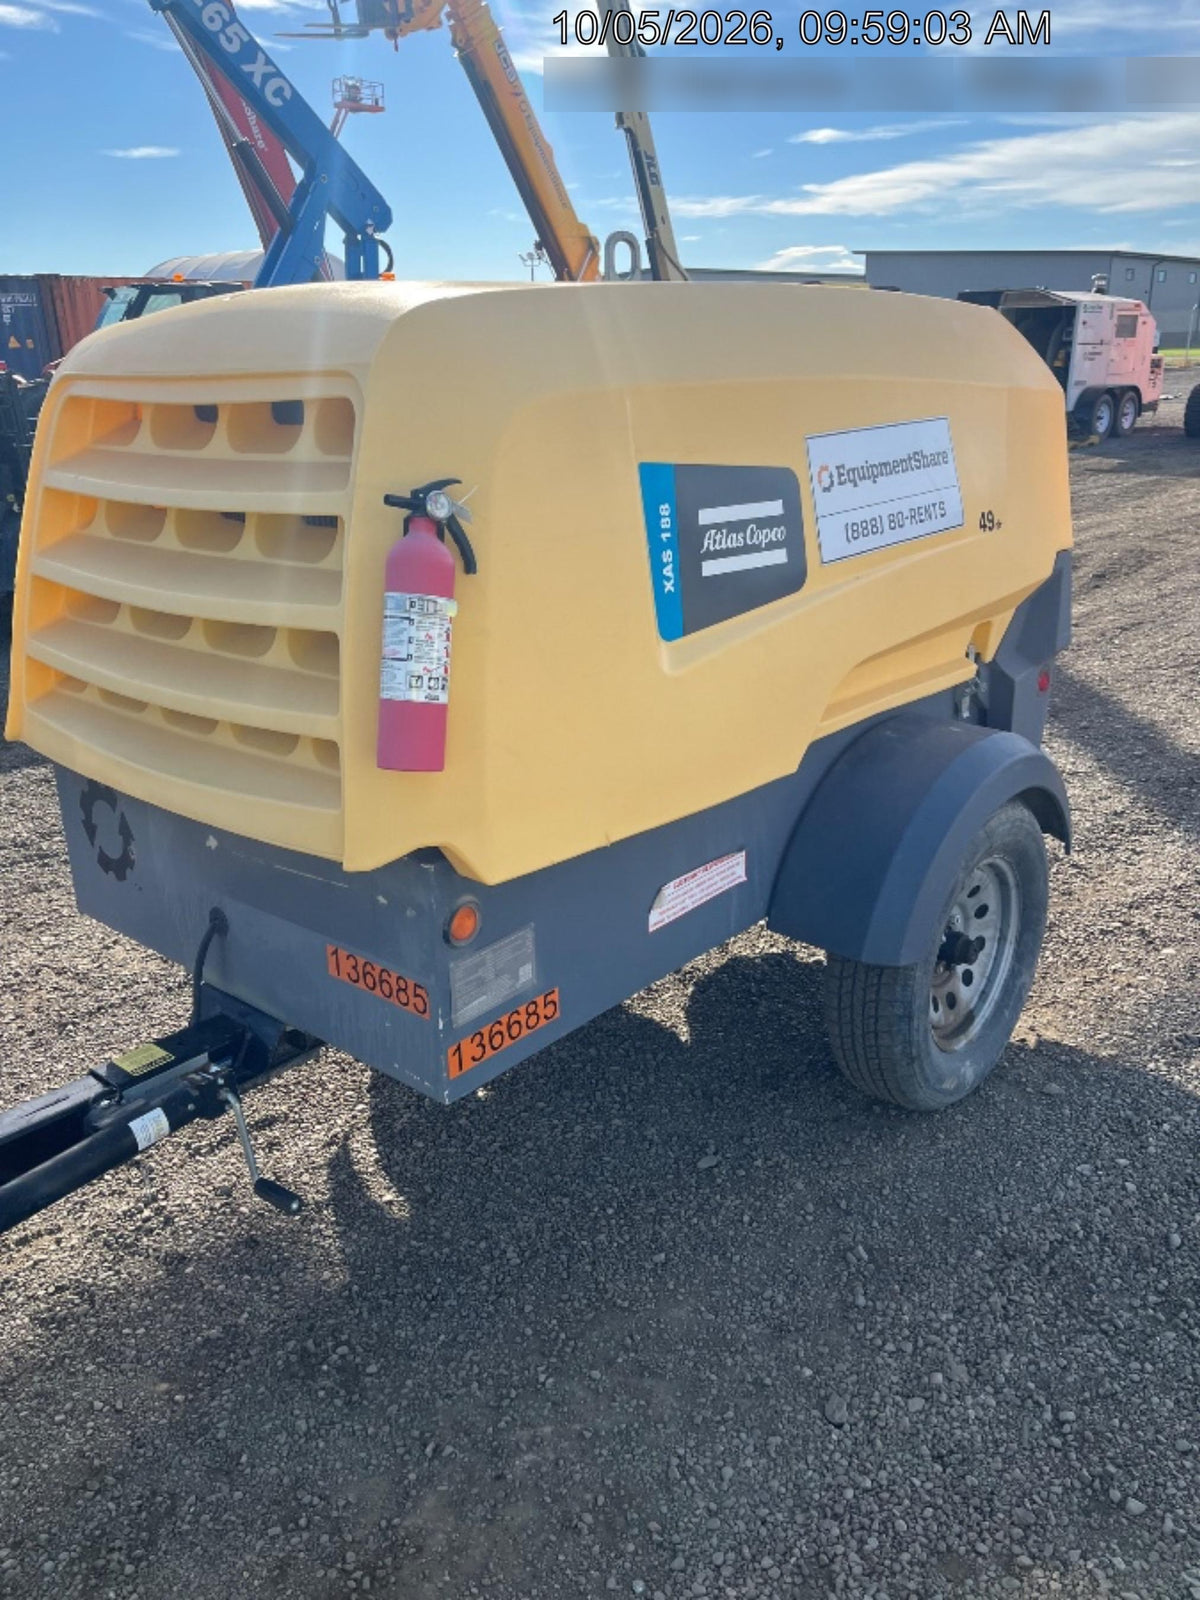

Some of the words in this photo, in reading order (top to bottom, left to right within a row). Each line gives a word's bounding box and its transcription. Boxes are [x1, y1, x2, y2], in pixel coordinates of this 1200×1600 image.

[240, 50, 292, 107] XC
[835, 450, 949, 488] EquipmentShare
[659, 503, 672, 542] 188
[700, 528, 744, 553] Atlas
[746, 524, 786, 547] Copco
[845, 515, 885, 543] (888)
[888, 501, 947, 531] 80-RENTS
[661, 549, 675, 594] XAS
[329, 947, 428, 1015] 136685
[452, 990, 558, 1072] 136685
